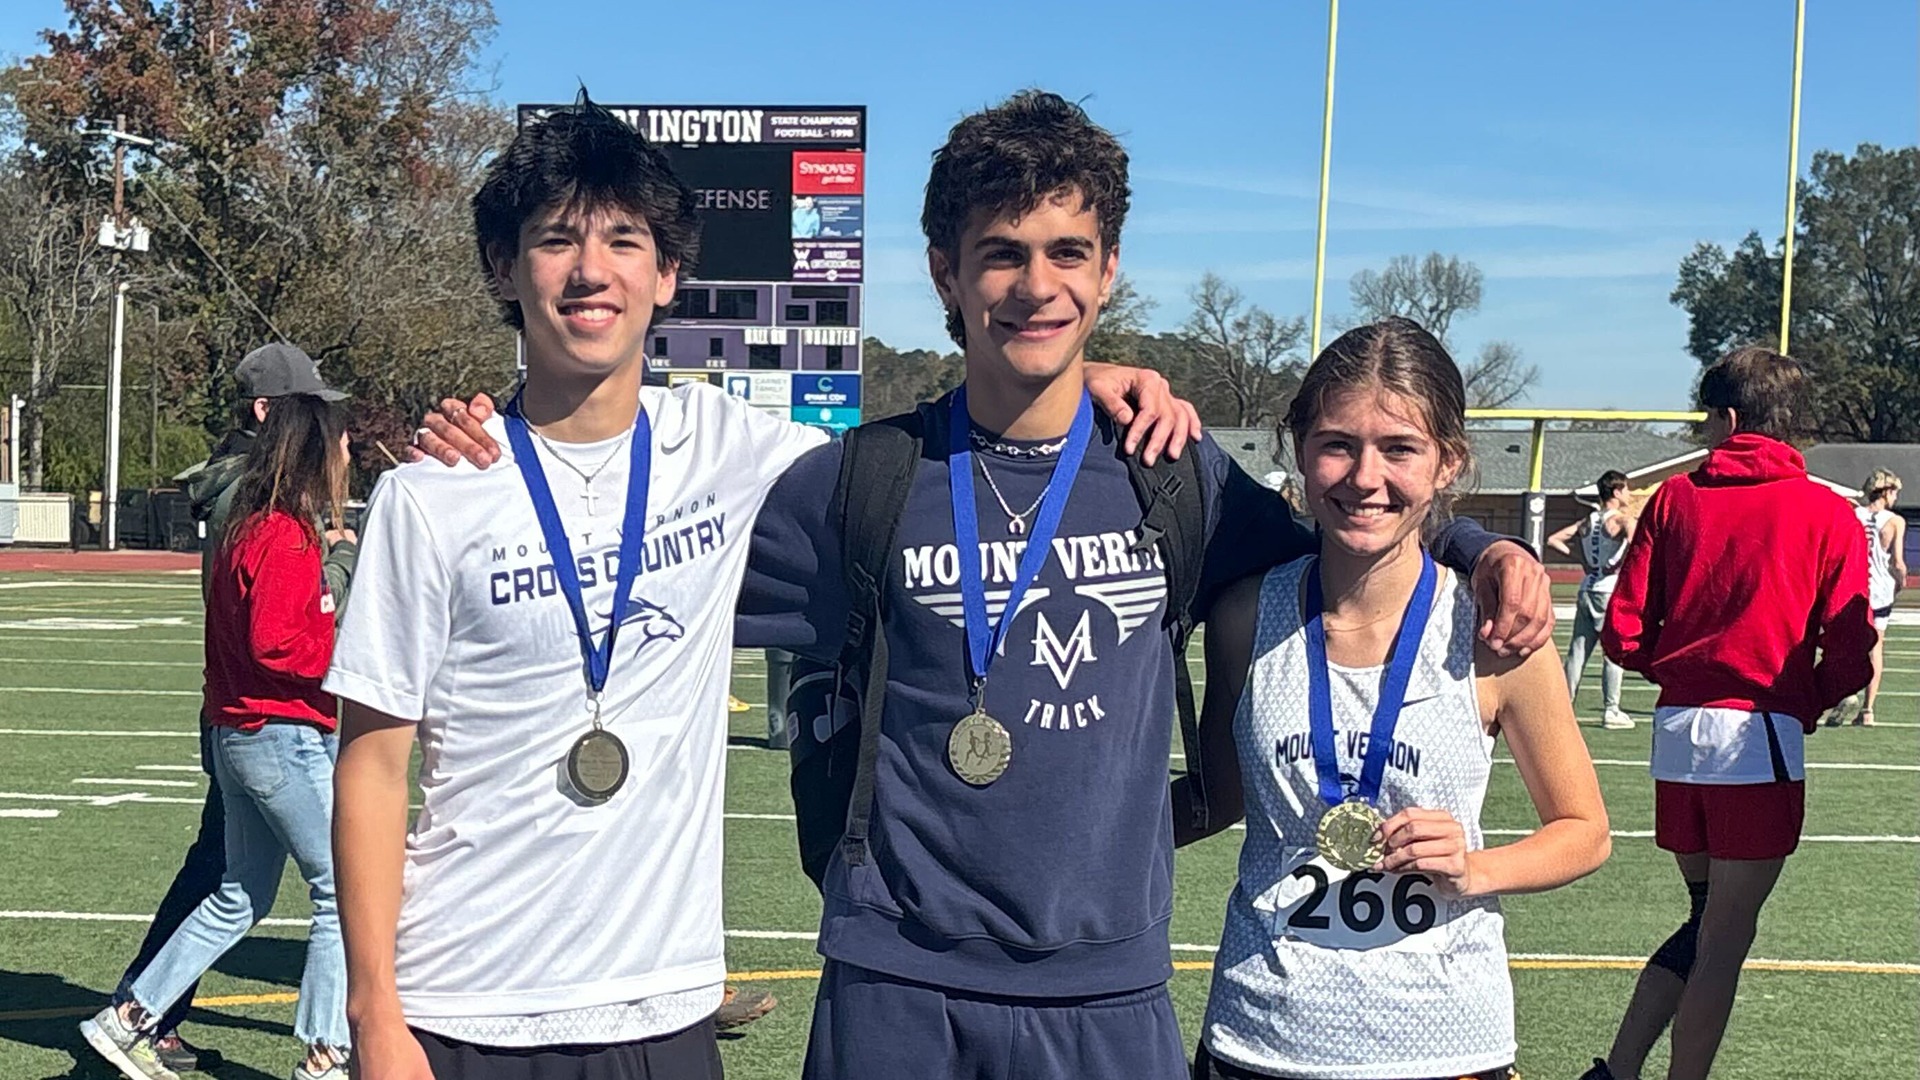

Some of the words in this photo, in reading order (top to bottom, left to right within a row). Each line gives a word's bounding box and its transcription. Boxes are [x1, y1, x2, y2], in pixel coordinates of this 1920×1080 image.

[771, 116, 799, 125] STATE
[800, 115, 859, 126] CHAMPIONS
[774, 129, 824, 138] FOOTBALL
[799, 162, 856, 174] SYNOVUS
[694, 189, 772, 210] EFENSE
[804, 329, 857, 346] QUARTER
[490, 555, 597, 606] CROS
[603, 512, 726, 583] CUNTRY
[491, 532, 593, 562] MOUT
[1023, 694, 1106, 731] TRACK
[1347, 729, 1421, 778] VENON
[1287, 862, 1437, 935] 266
